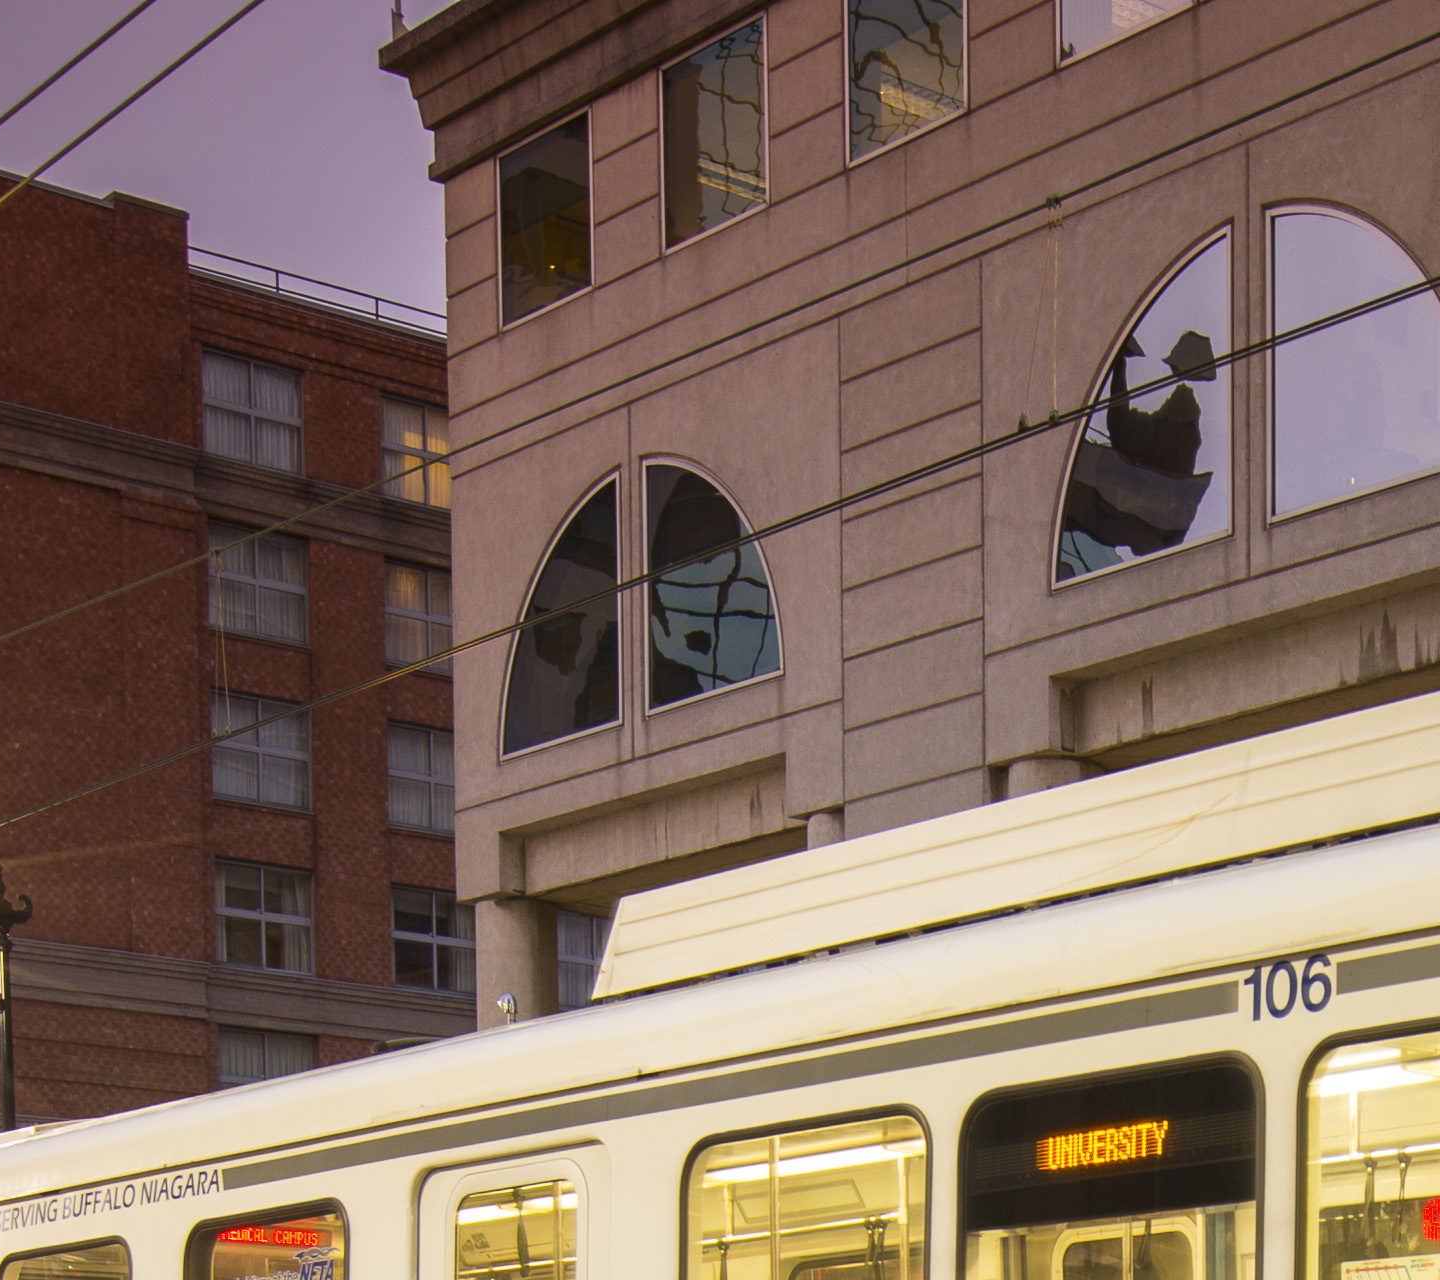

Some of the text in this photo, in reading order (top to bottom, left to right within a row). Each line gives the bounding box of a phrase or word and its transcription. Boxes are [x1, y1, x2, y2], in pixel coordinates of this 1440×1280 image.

[1244, 953, 1332, 1021] 106
[1043, 1120, 1169, 1170] UNIVERSITY
[61, 1184, 136, 1220] BUFFALO
[139, 1168, 220, 1206] NIAGARA
[275, 1230, 319, 1246] CAMPUS
